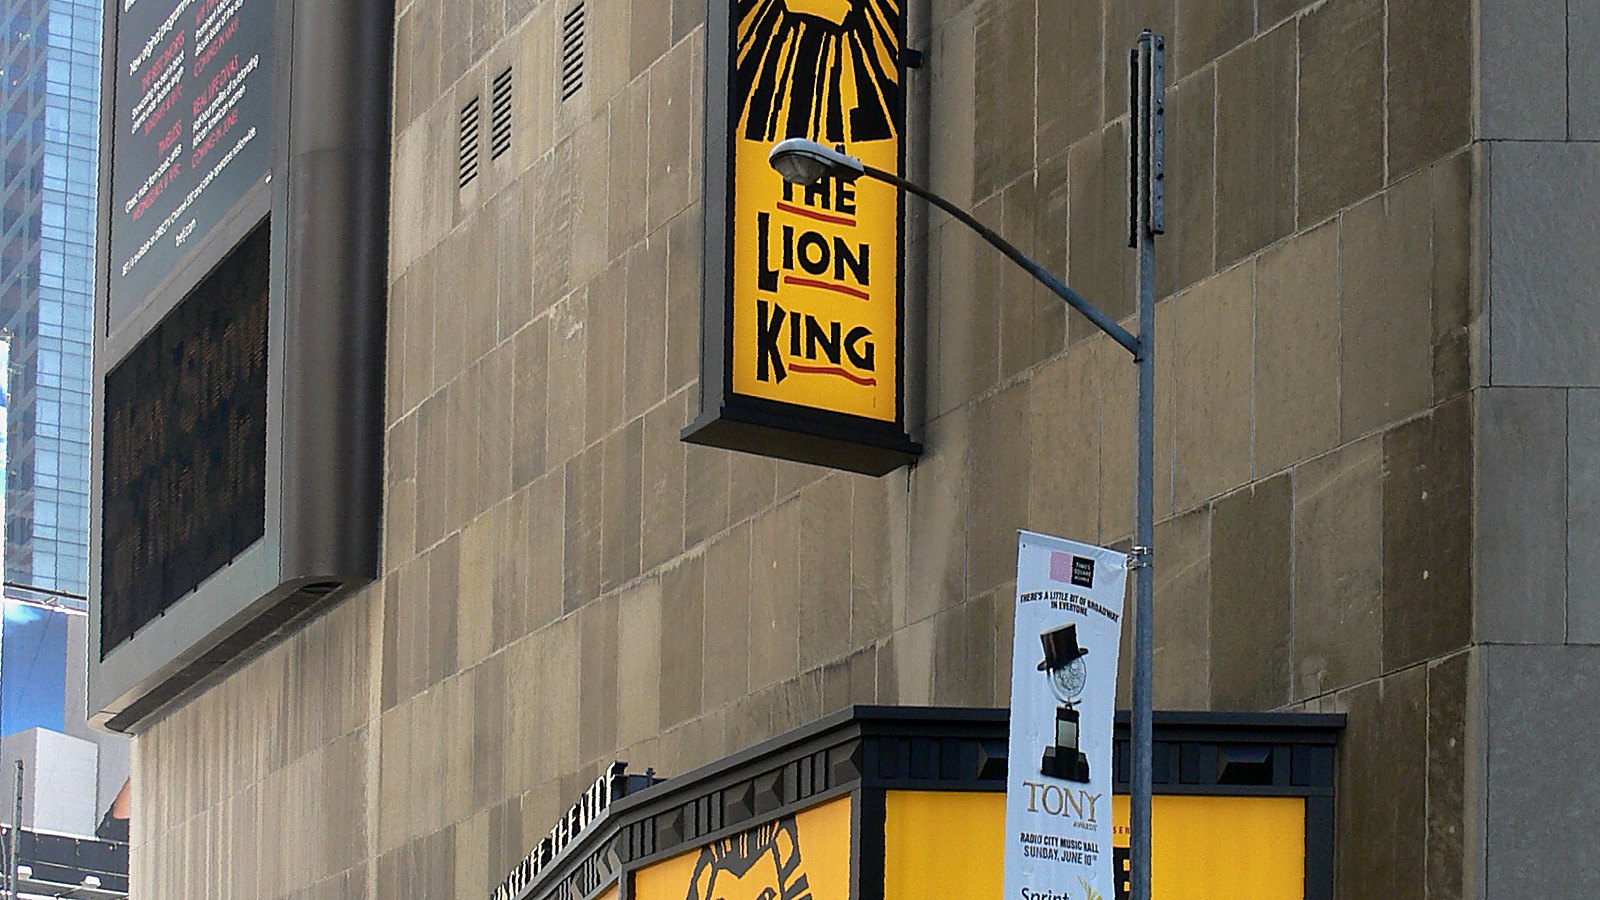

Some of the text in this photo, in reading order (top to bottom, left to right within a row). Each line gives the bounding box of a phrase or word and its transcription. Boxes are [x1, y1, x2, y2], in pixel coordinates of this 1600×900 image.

[757, 211, 870, 293] LION
[756, 299, 876, 385] KING
[1020, 591, 1119, 623] THERE'S A LITTLE BIT OF BROADWAY
[1051, 601, 1088, 616] IN EVERYONE
[1023, 781, 1102, 823] TONY
[1020, 832, 1099, 854] RADIO CITY MUSIC HALL
[1023, 845, 1060, 862] SUNDAY,
[1061, 849, 1082, 865] JUNE
